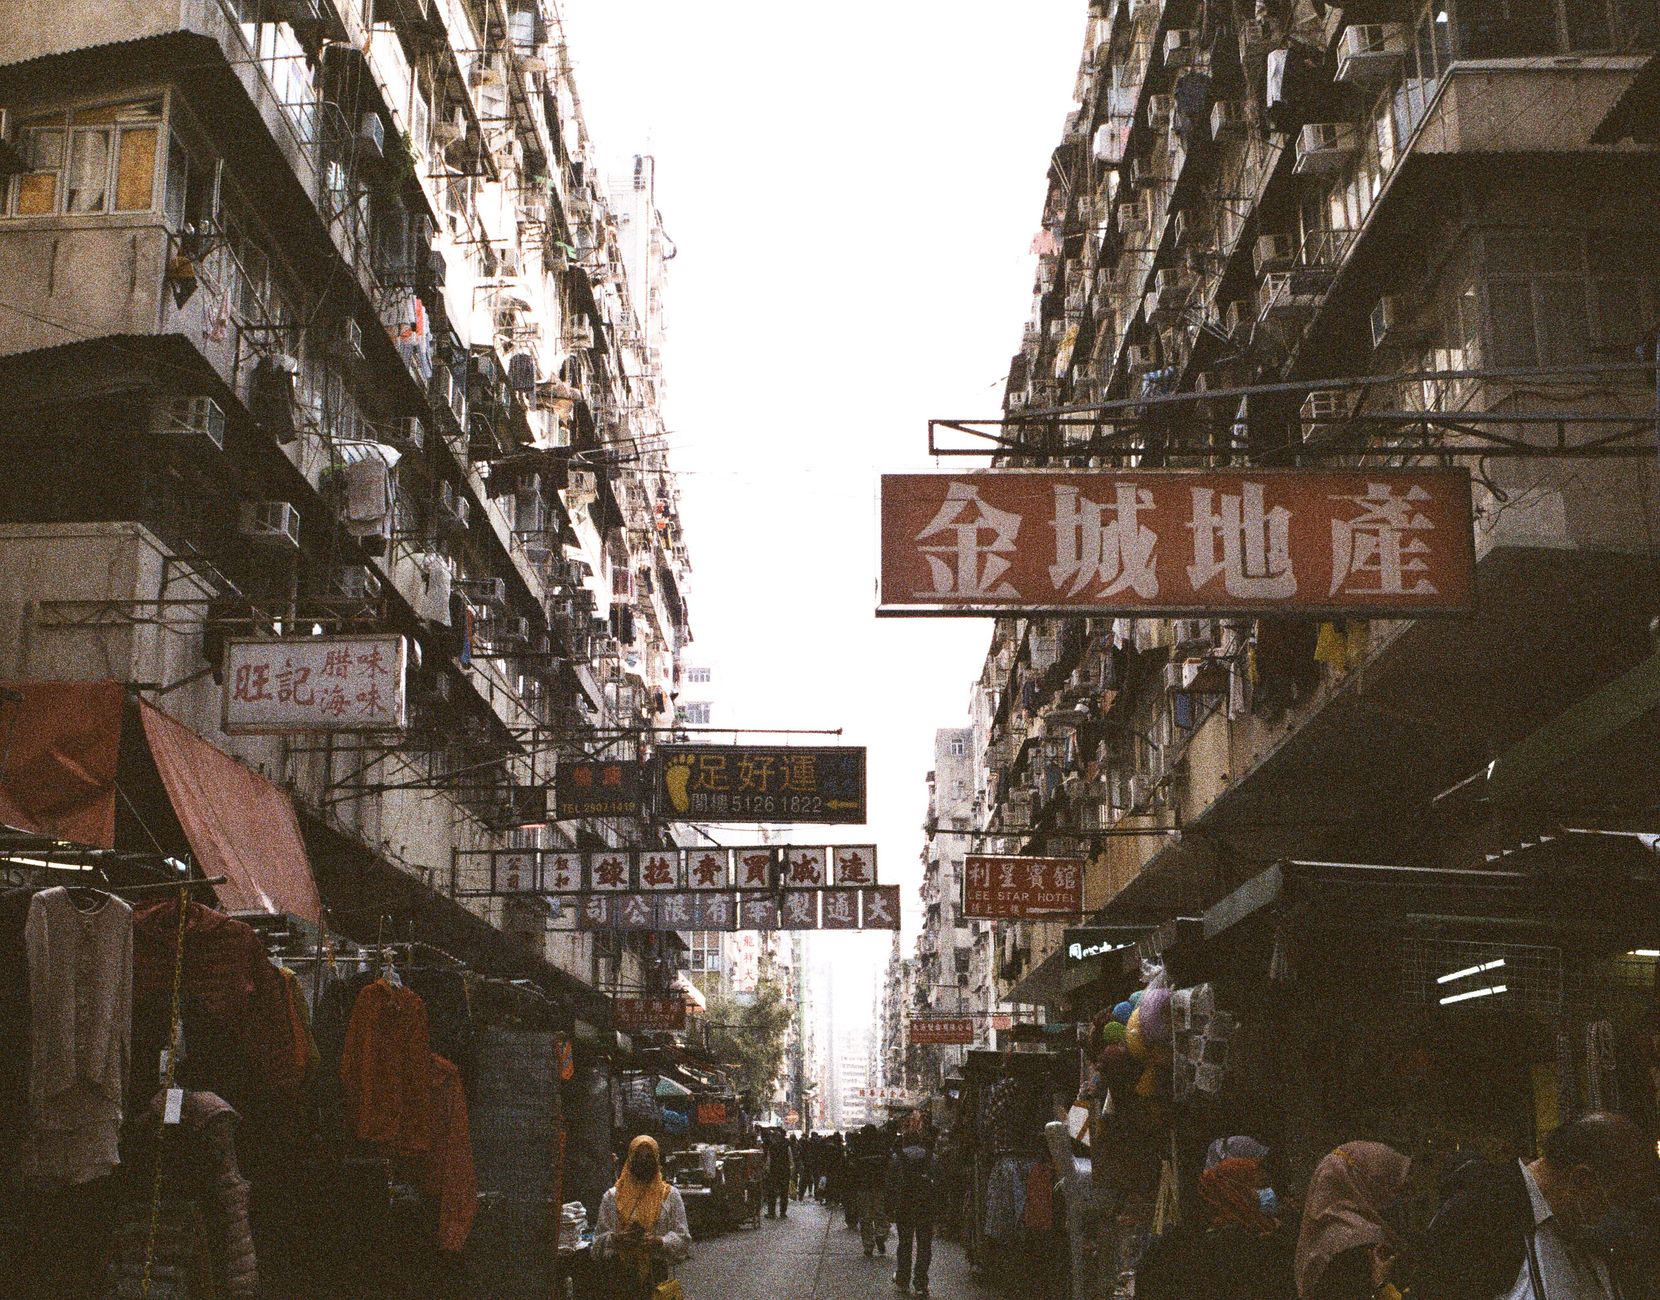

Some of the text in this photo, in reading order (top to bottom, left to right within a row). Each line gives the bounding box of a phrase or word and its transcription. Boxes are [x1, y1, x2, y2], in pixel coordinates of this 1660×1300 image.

[912, 481, 1439, 600] 金城地產
[234, 657, 315, 706] 旺記
[320, 682, 388, 717] 海味
[692, 754, 816, 792] 足好運
[732, 796, 774, 813] 5126
[782, 796, 823, 813] 1822
[998, 891, 1030, 902] STAR
[1037, 892, 1076, 903] HOTEL
